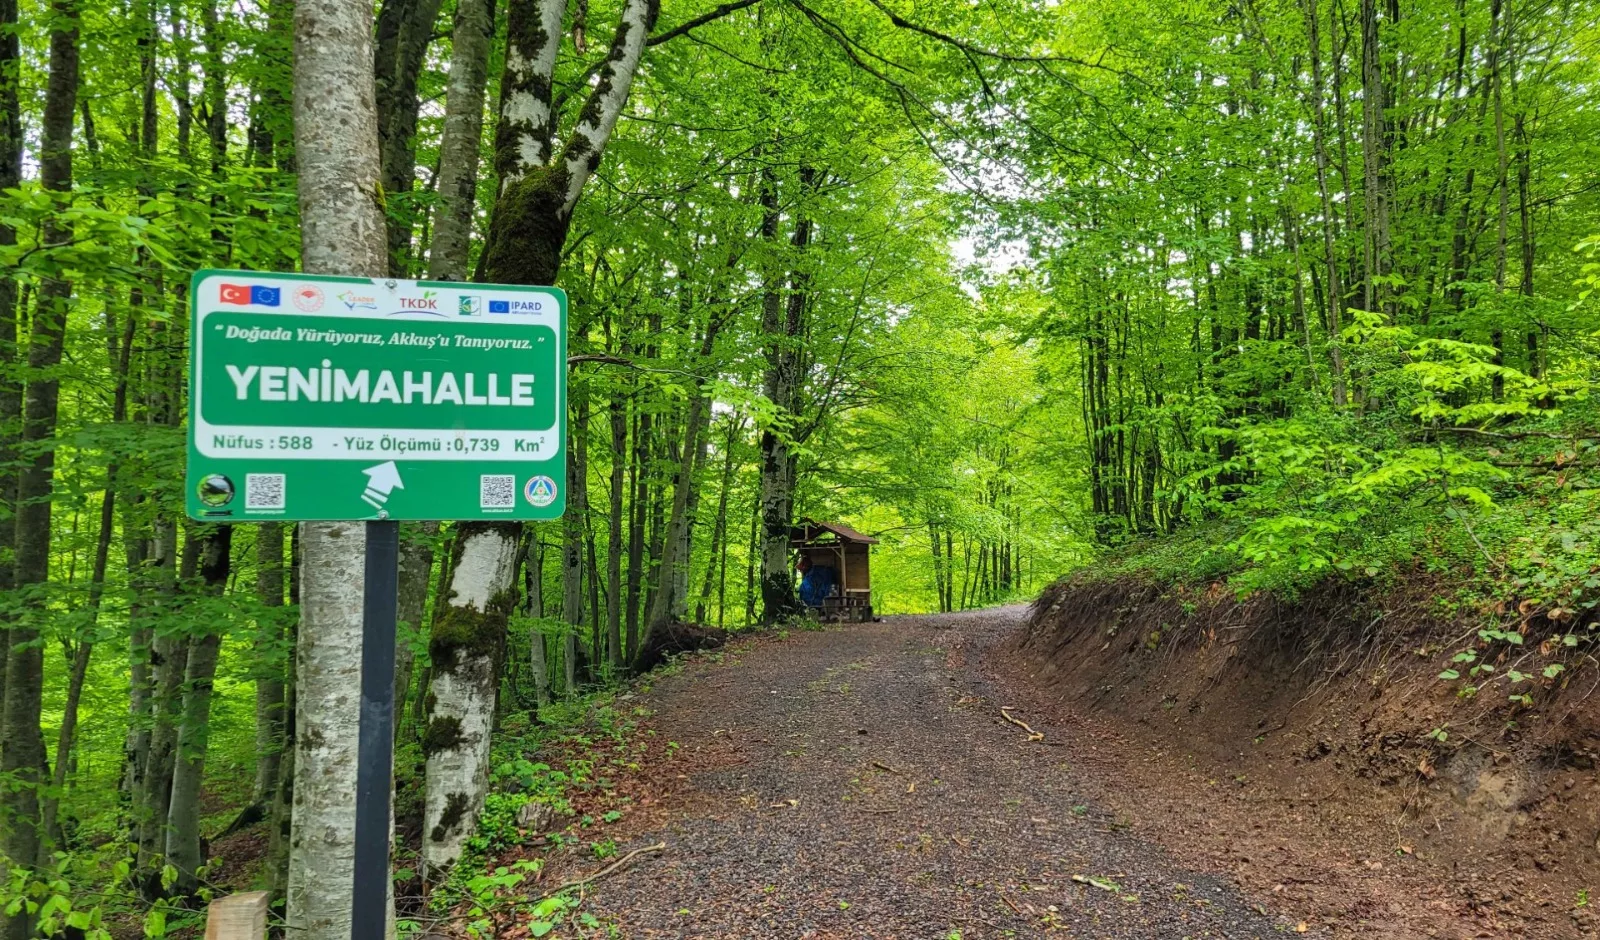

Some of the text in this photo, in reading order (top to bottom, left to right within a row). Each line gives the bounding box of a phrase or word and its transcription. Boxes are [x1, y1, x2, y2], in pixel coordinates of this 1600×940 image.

[400, 298, 437, 310] TKDK
[511, 301, 542, 311] IPARD
[225, 325, 292, 342] Doğada
[297, 328, 385, 346] Yürüyoruz,
[454, 335, 533, 351] Tanıyoruz.
[225, 358, 535, 406] YENİMAHALLE
[213, 435, 264, 449] Nüfus
[344, 436, 374, 450] Yüz
[380, 434, 441, 454] Ölçümü
